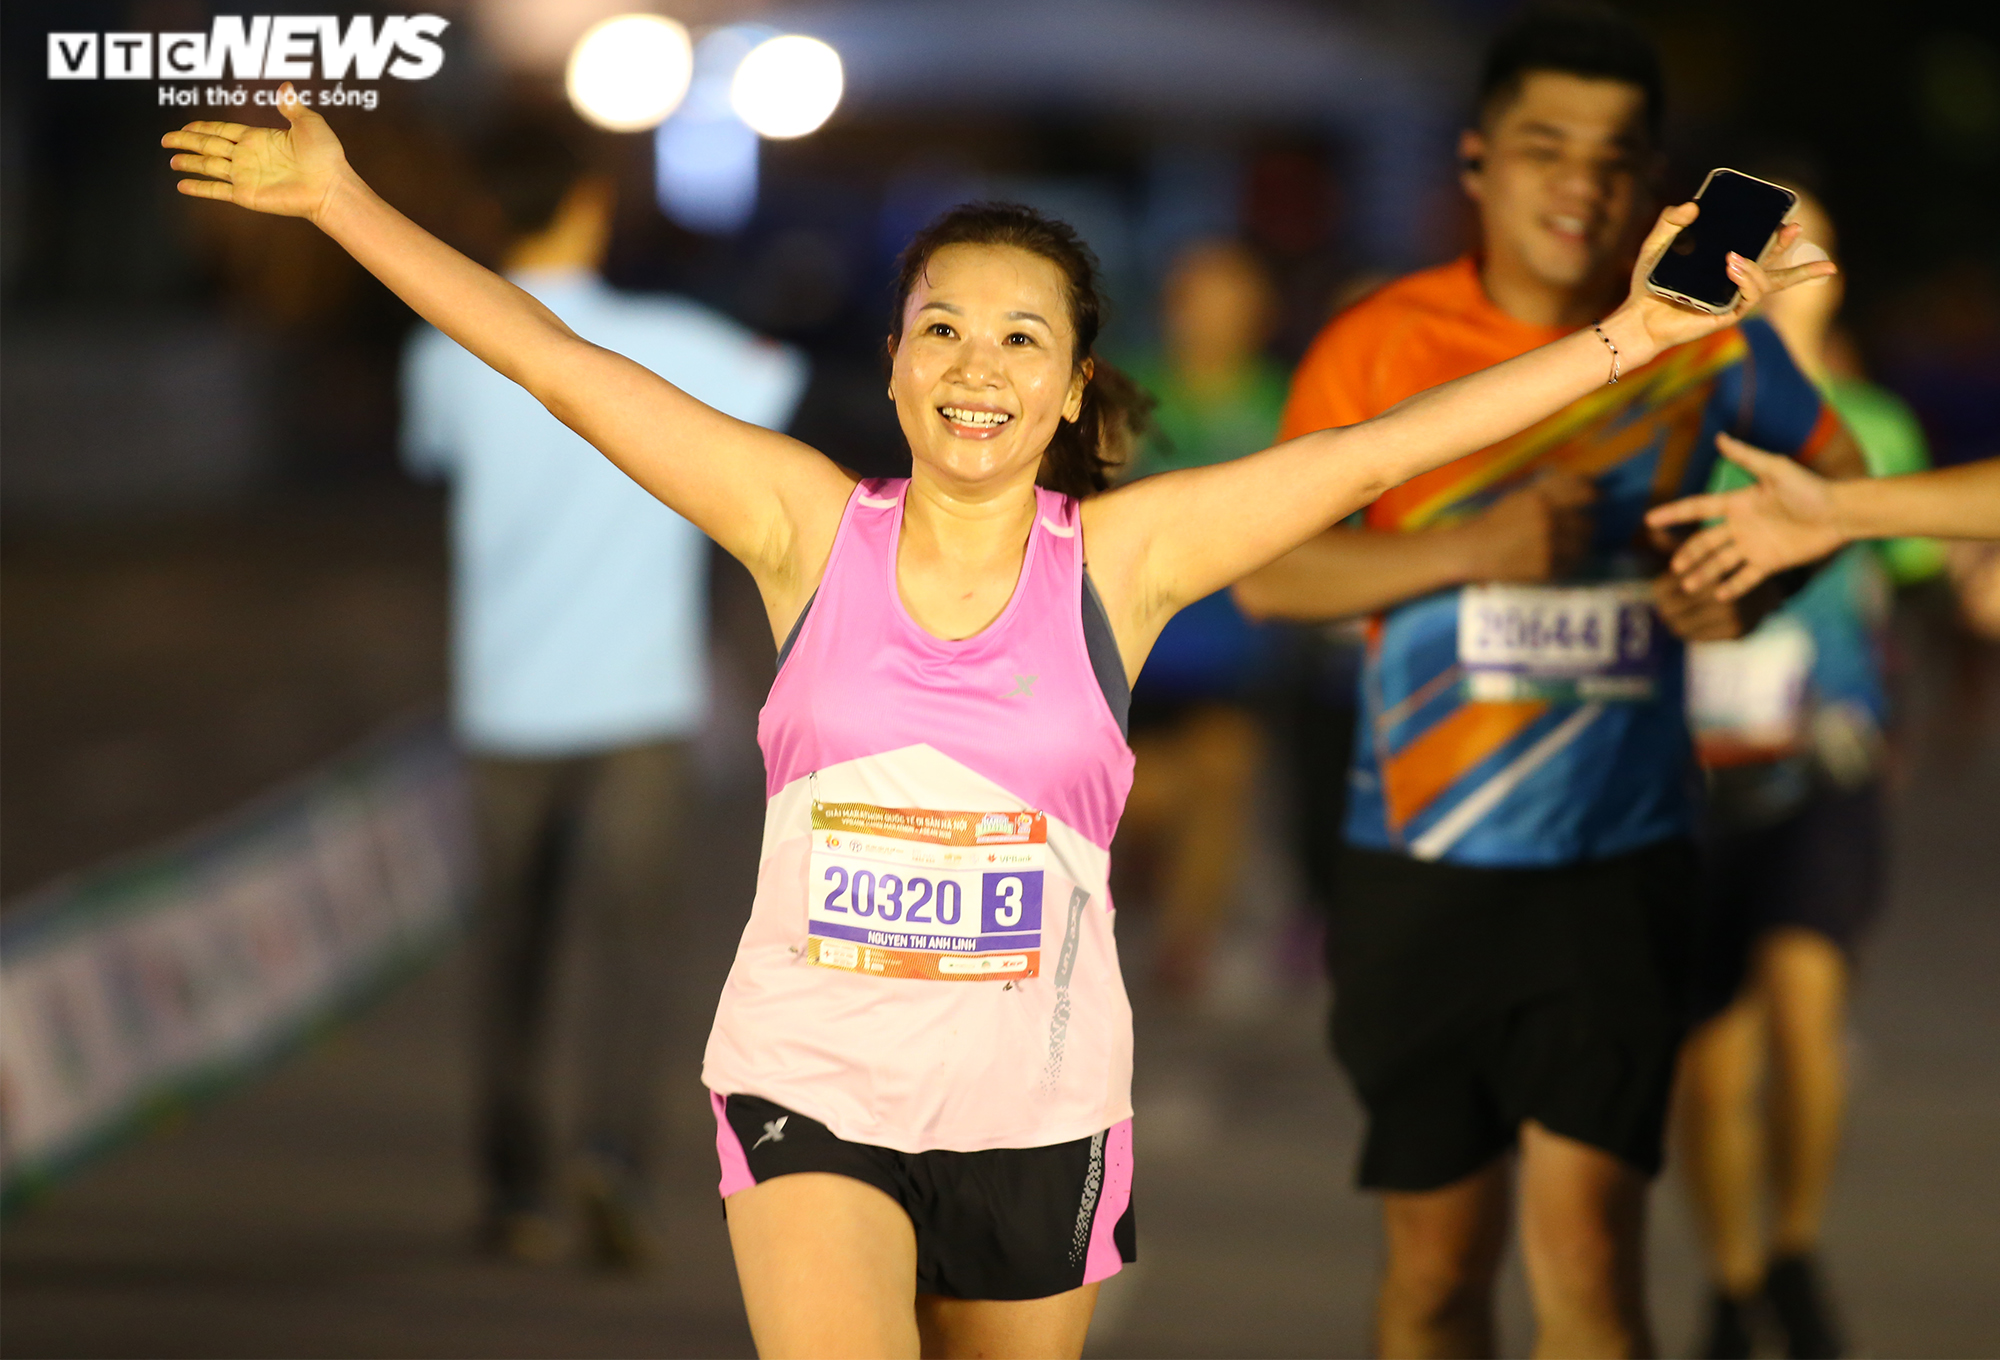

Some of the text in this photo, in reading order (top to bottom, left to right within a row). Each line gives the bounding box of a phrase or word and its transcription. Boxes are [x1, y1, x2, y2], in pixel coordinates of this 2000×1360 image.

[824, 866, 1024, 927] 20320 3
[910, 935, 927, 948] THI
[928, 936, 951, 950] ANH
[952, 937, 977, 951] LINH
